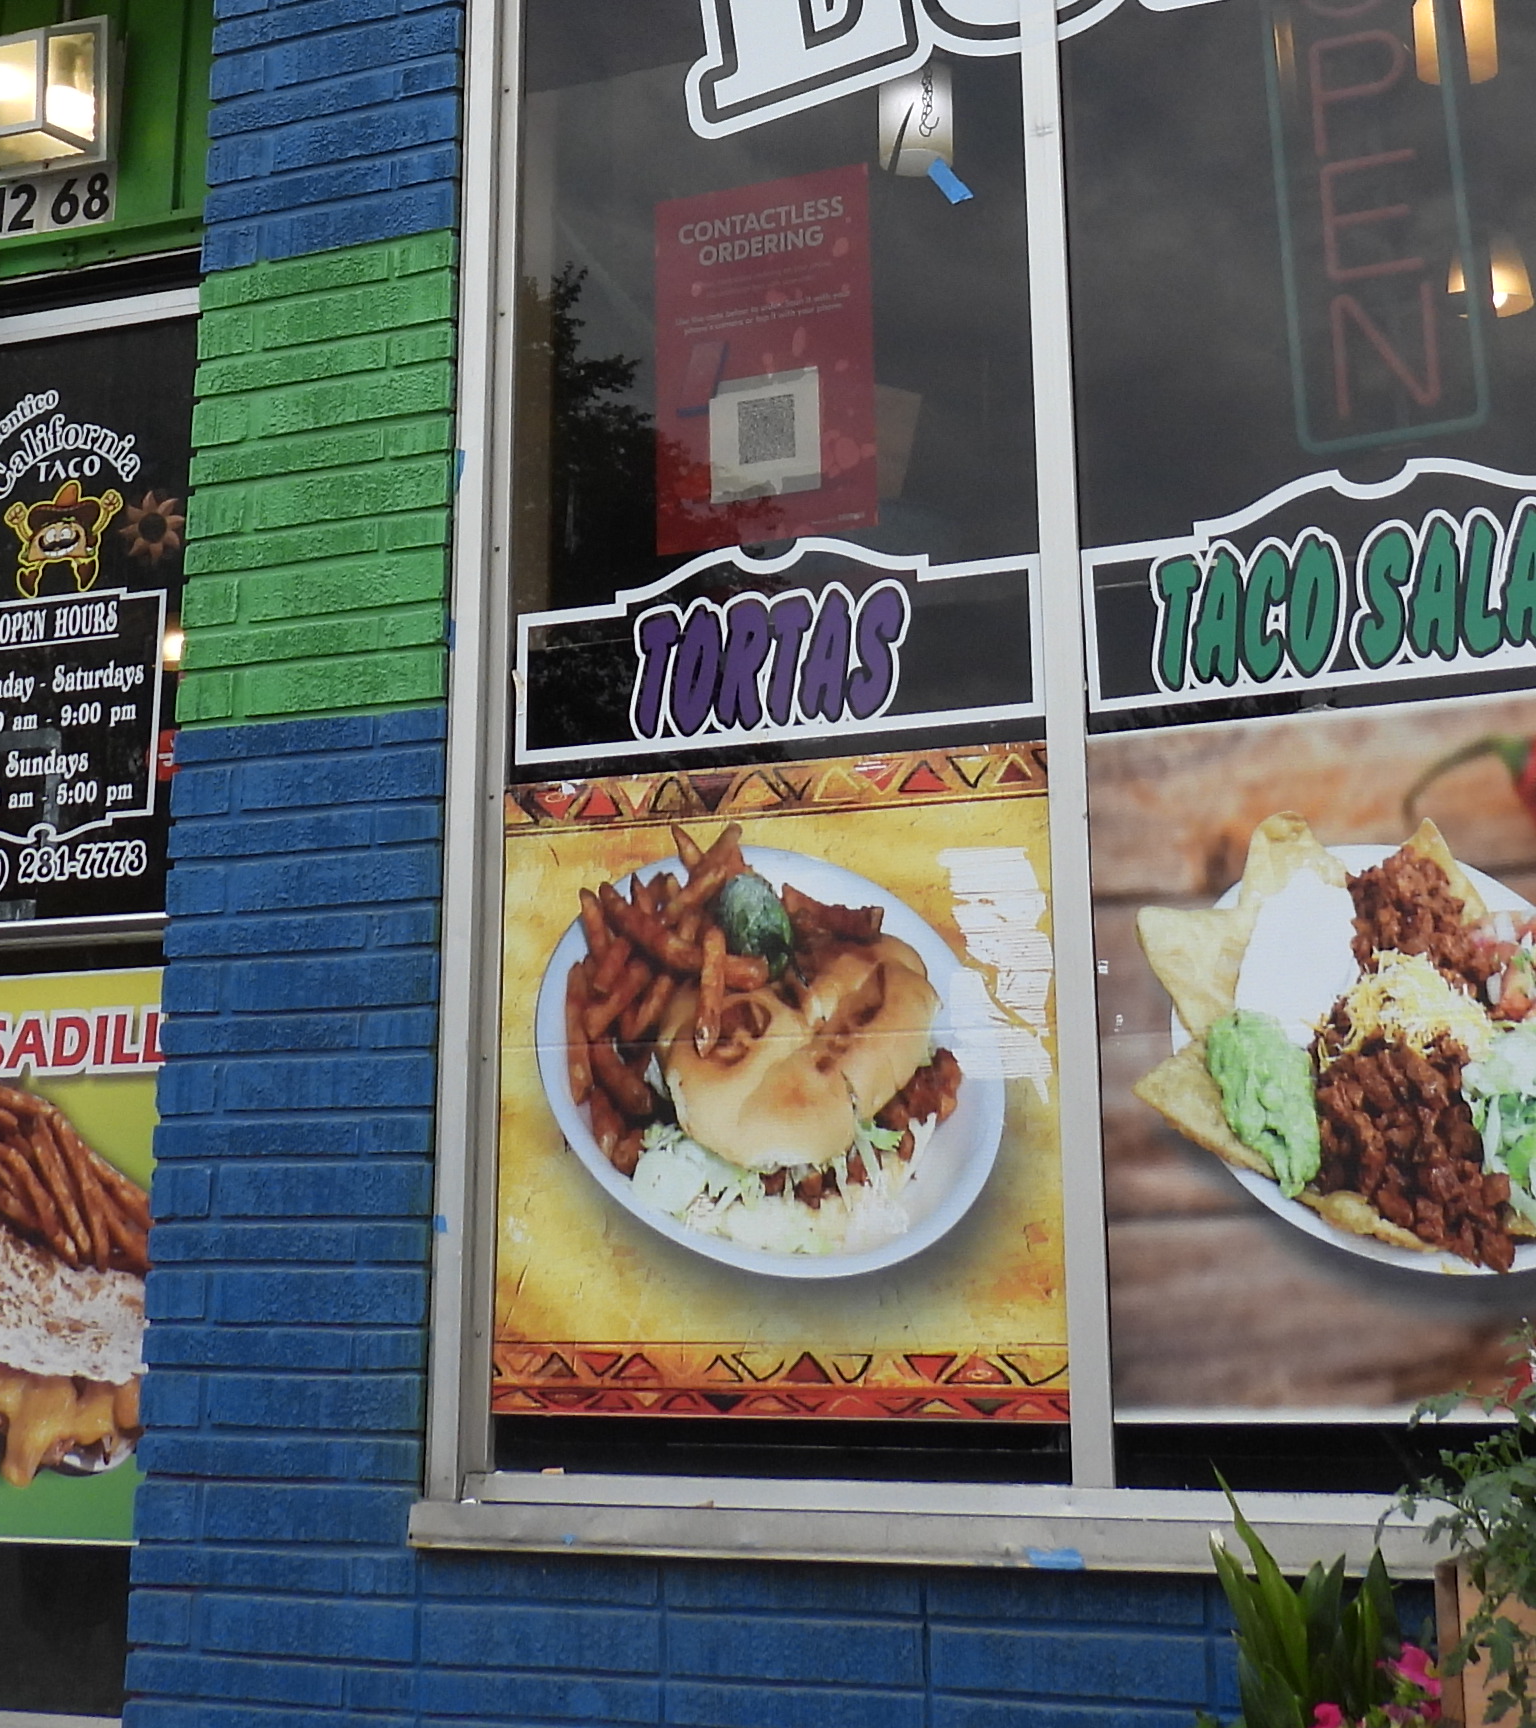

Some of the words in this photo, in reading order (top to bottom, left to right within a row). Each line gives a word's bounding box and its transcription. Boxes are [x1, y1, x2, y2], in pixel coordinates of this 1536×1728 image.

[678, 195, 844, 245] CONTACTLESS
[699, 225, 824, 266] ORDERING
[36, 455, 101, 482] TACO
[54, 601, 118, 638] HOURS
[1149, 526, 1346, 693] TACO
[52, 660, 145, 693] Saturdays
[629, 578, 911, 742] TORTAS
[12, 713, 38, 731] am
[60, 702, 101, 727] 9:00
[109, 703, 136, 727] pm
[5, 748, 89, 779] Sundays
[8, 791, 34, 809] am
[56, 781, 97, 805] 5:00
[105, 783, 133, 806] pm
[18, 840, 147, 883] 281-7773
